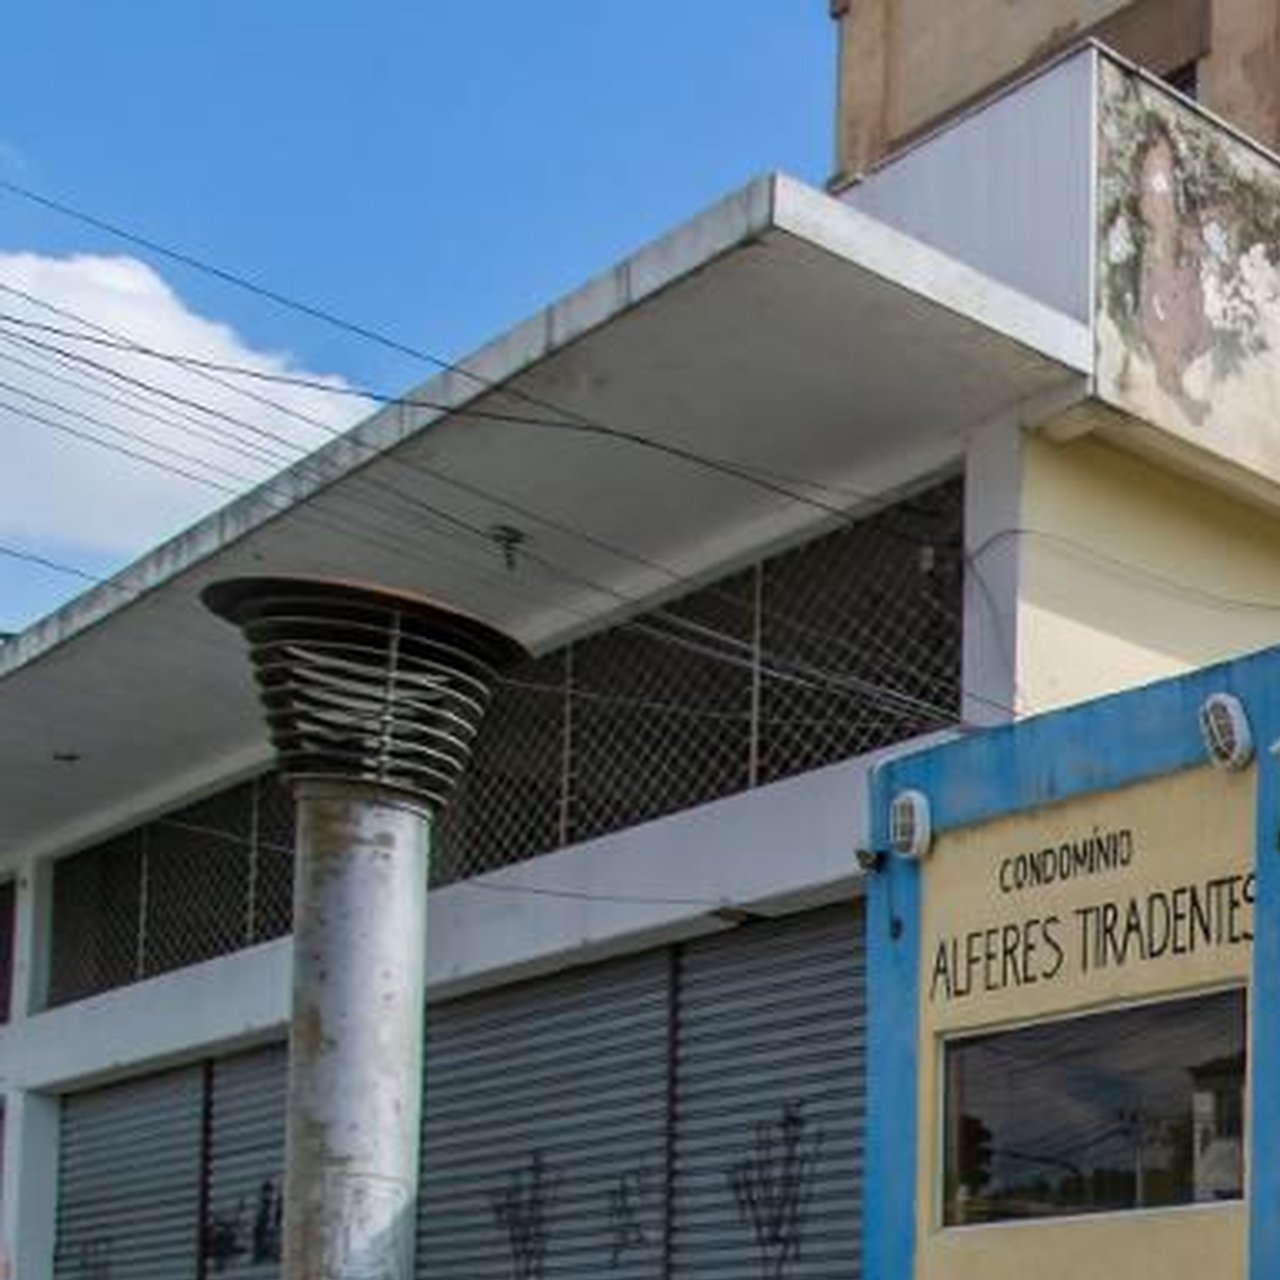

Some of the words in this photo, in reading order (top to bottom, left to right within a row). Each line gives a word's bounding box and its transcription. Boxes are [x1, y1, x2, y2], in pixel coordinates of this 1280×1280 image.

[999, 826, 1134, 893] CONDOMÍNIO
[930, 915, 1065, 1001] ALFERES
[1074, 872, 1256, 976] TIRADENTES
